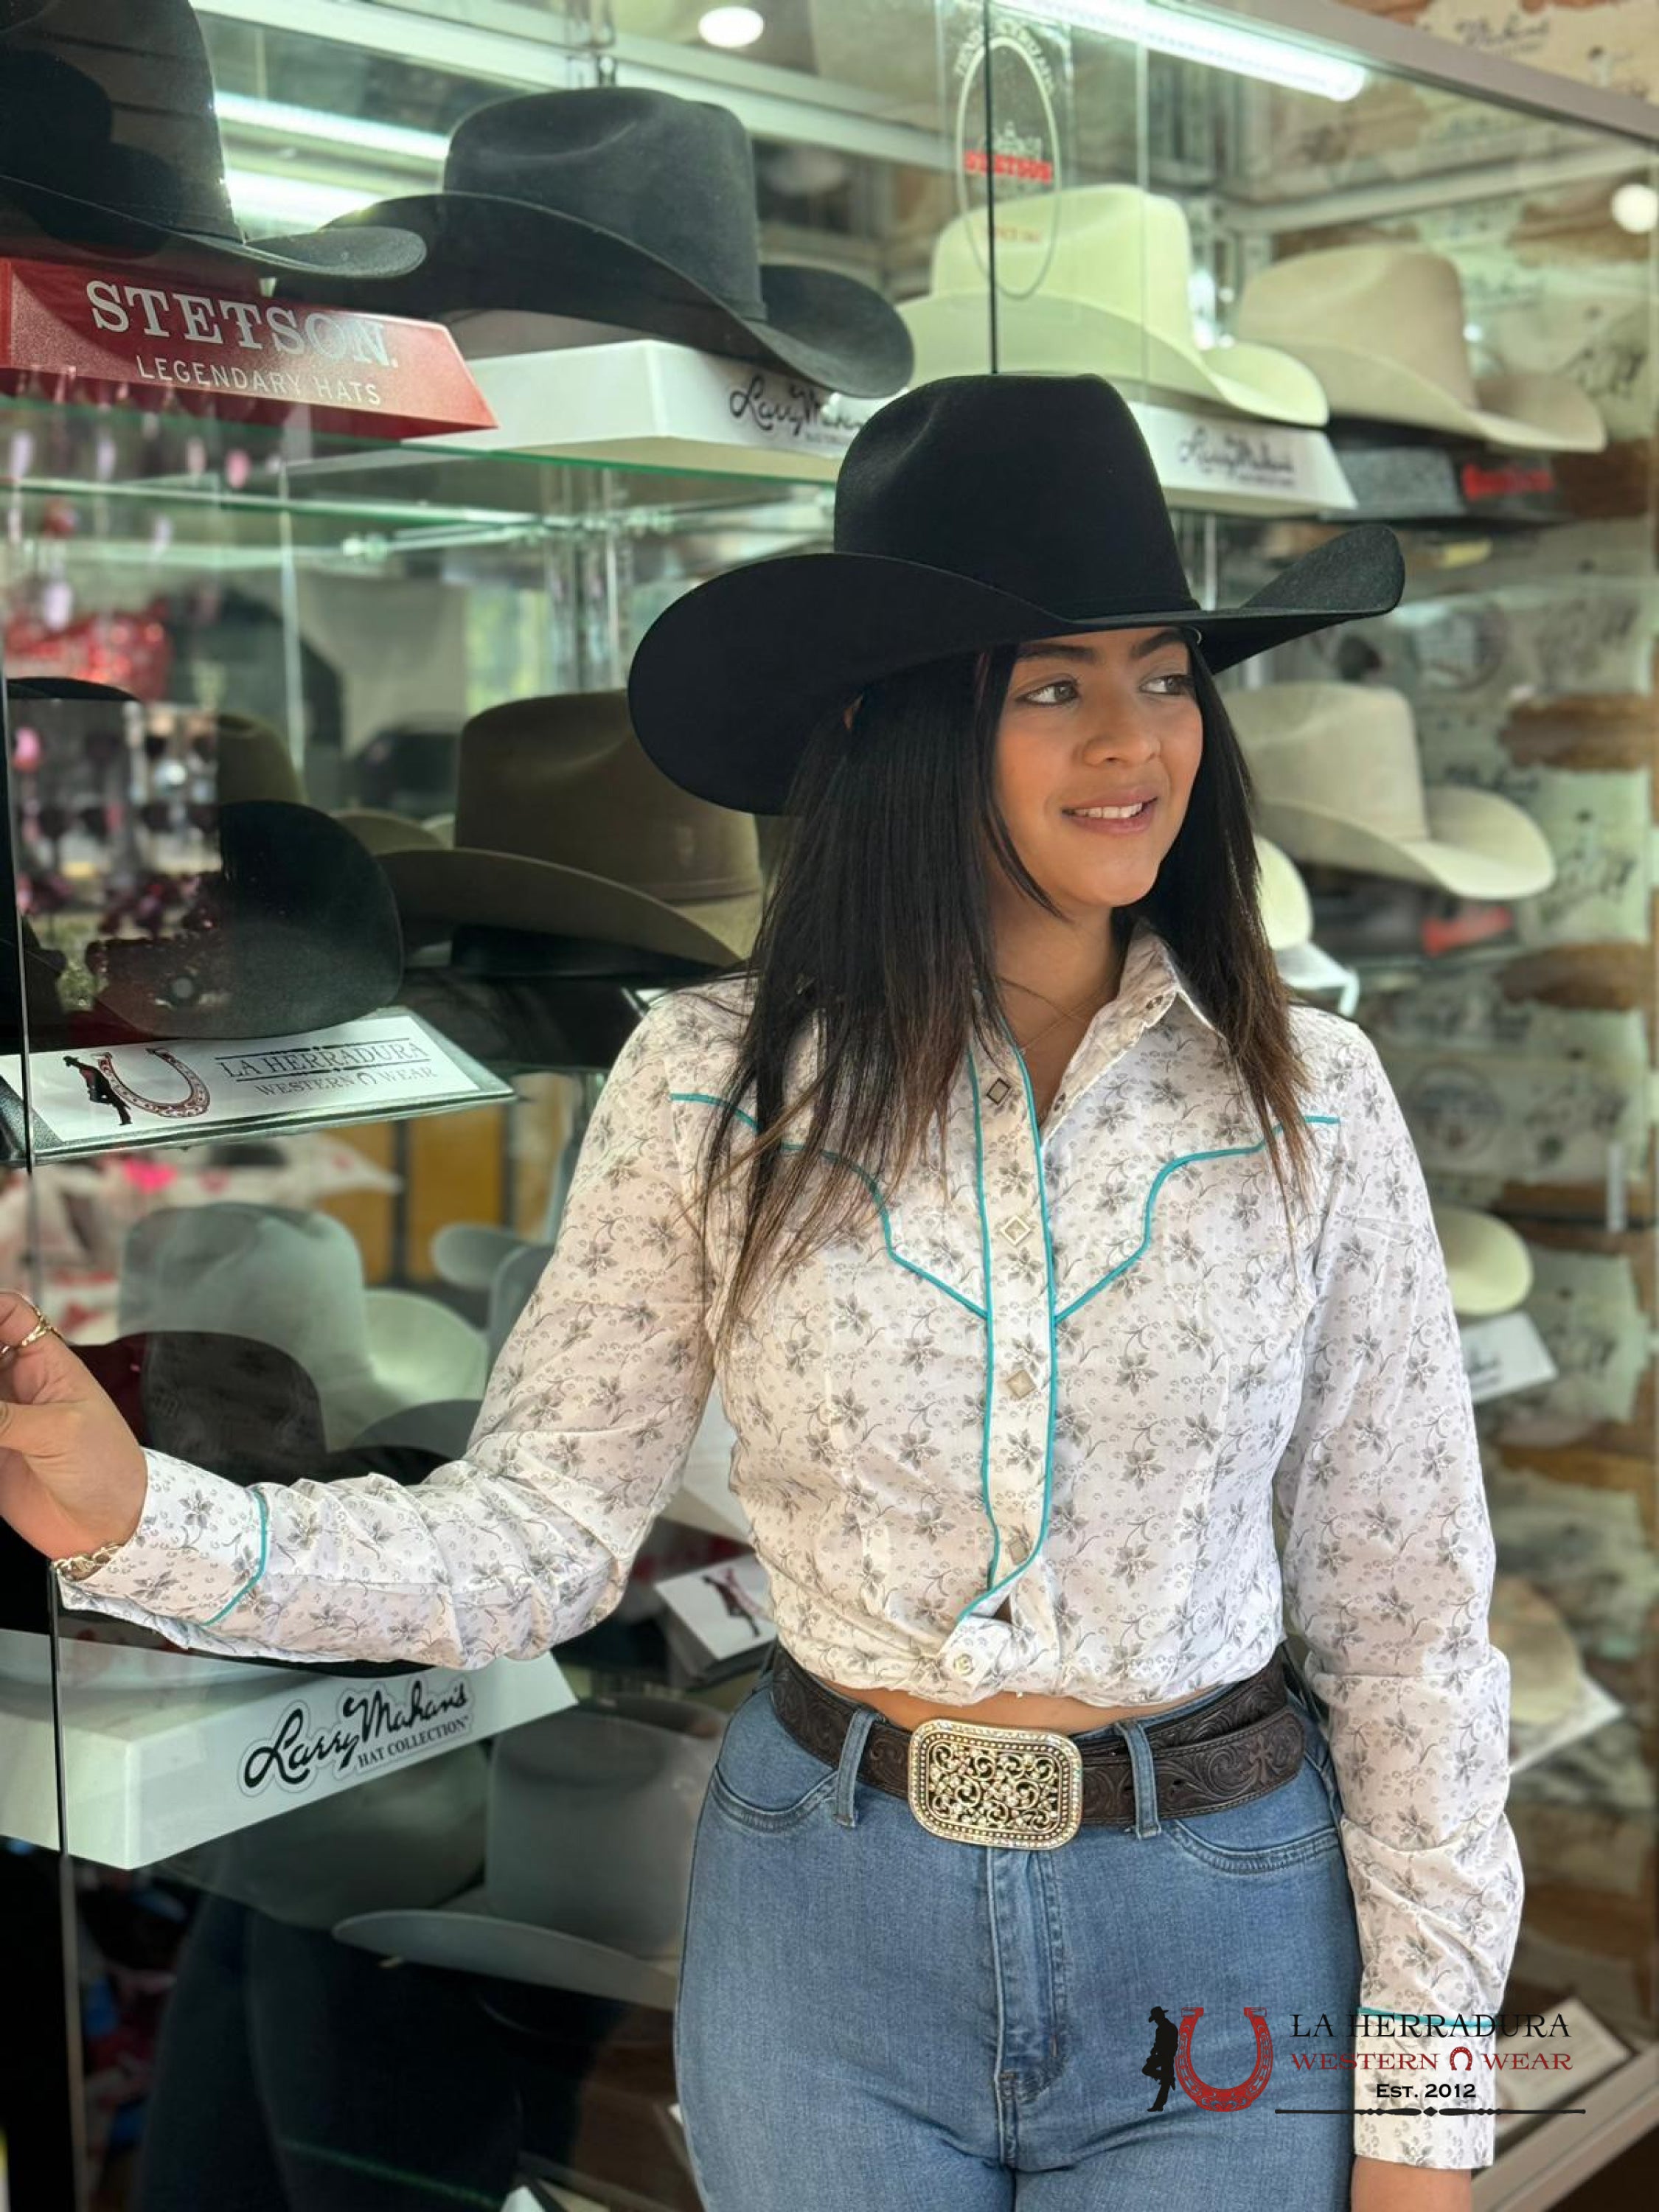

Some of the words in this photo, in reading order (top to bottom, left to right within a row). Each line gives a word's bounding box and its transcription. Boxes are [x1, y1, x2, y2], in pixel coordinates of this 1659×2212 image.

[136, 355, 301, 396] LEGENDARY
[313, 375, 380, 406] HATS
[220, 1059, 262, 1077] LA
[262, 1041, 429, 1073] HERRADURA
[255, 1074, 355, 1096] WESTERN
[379, 1065, 437, 1082] WEAR
[244, 1708, 360, 1788] Larry
[358, 1747, 386, 1768] HAT
[388, 1719, 467, 1756] COLLECTION
